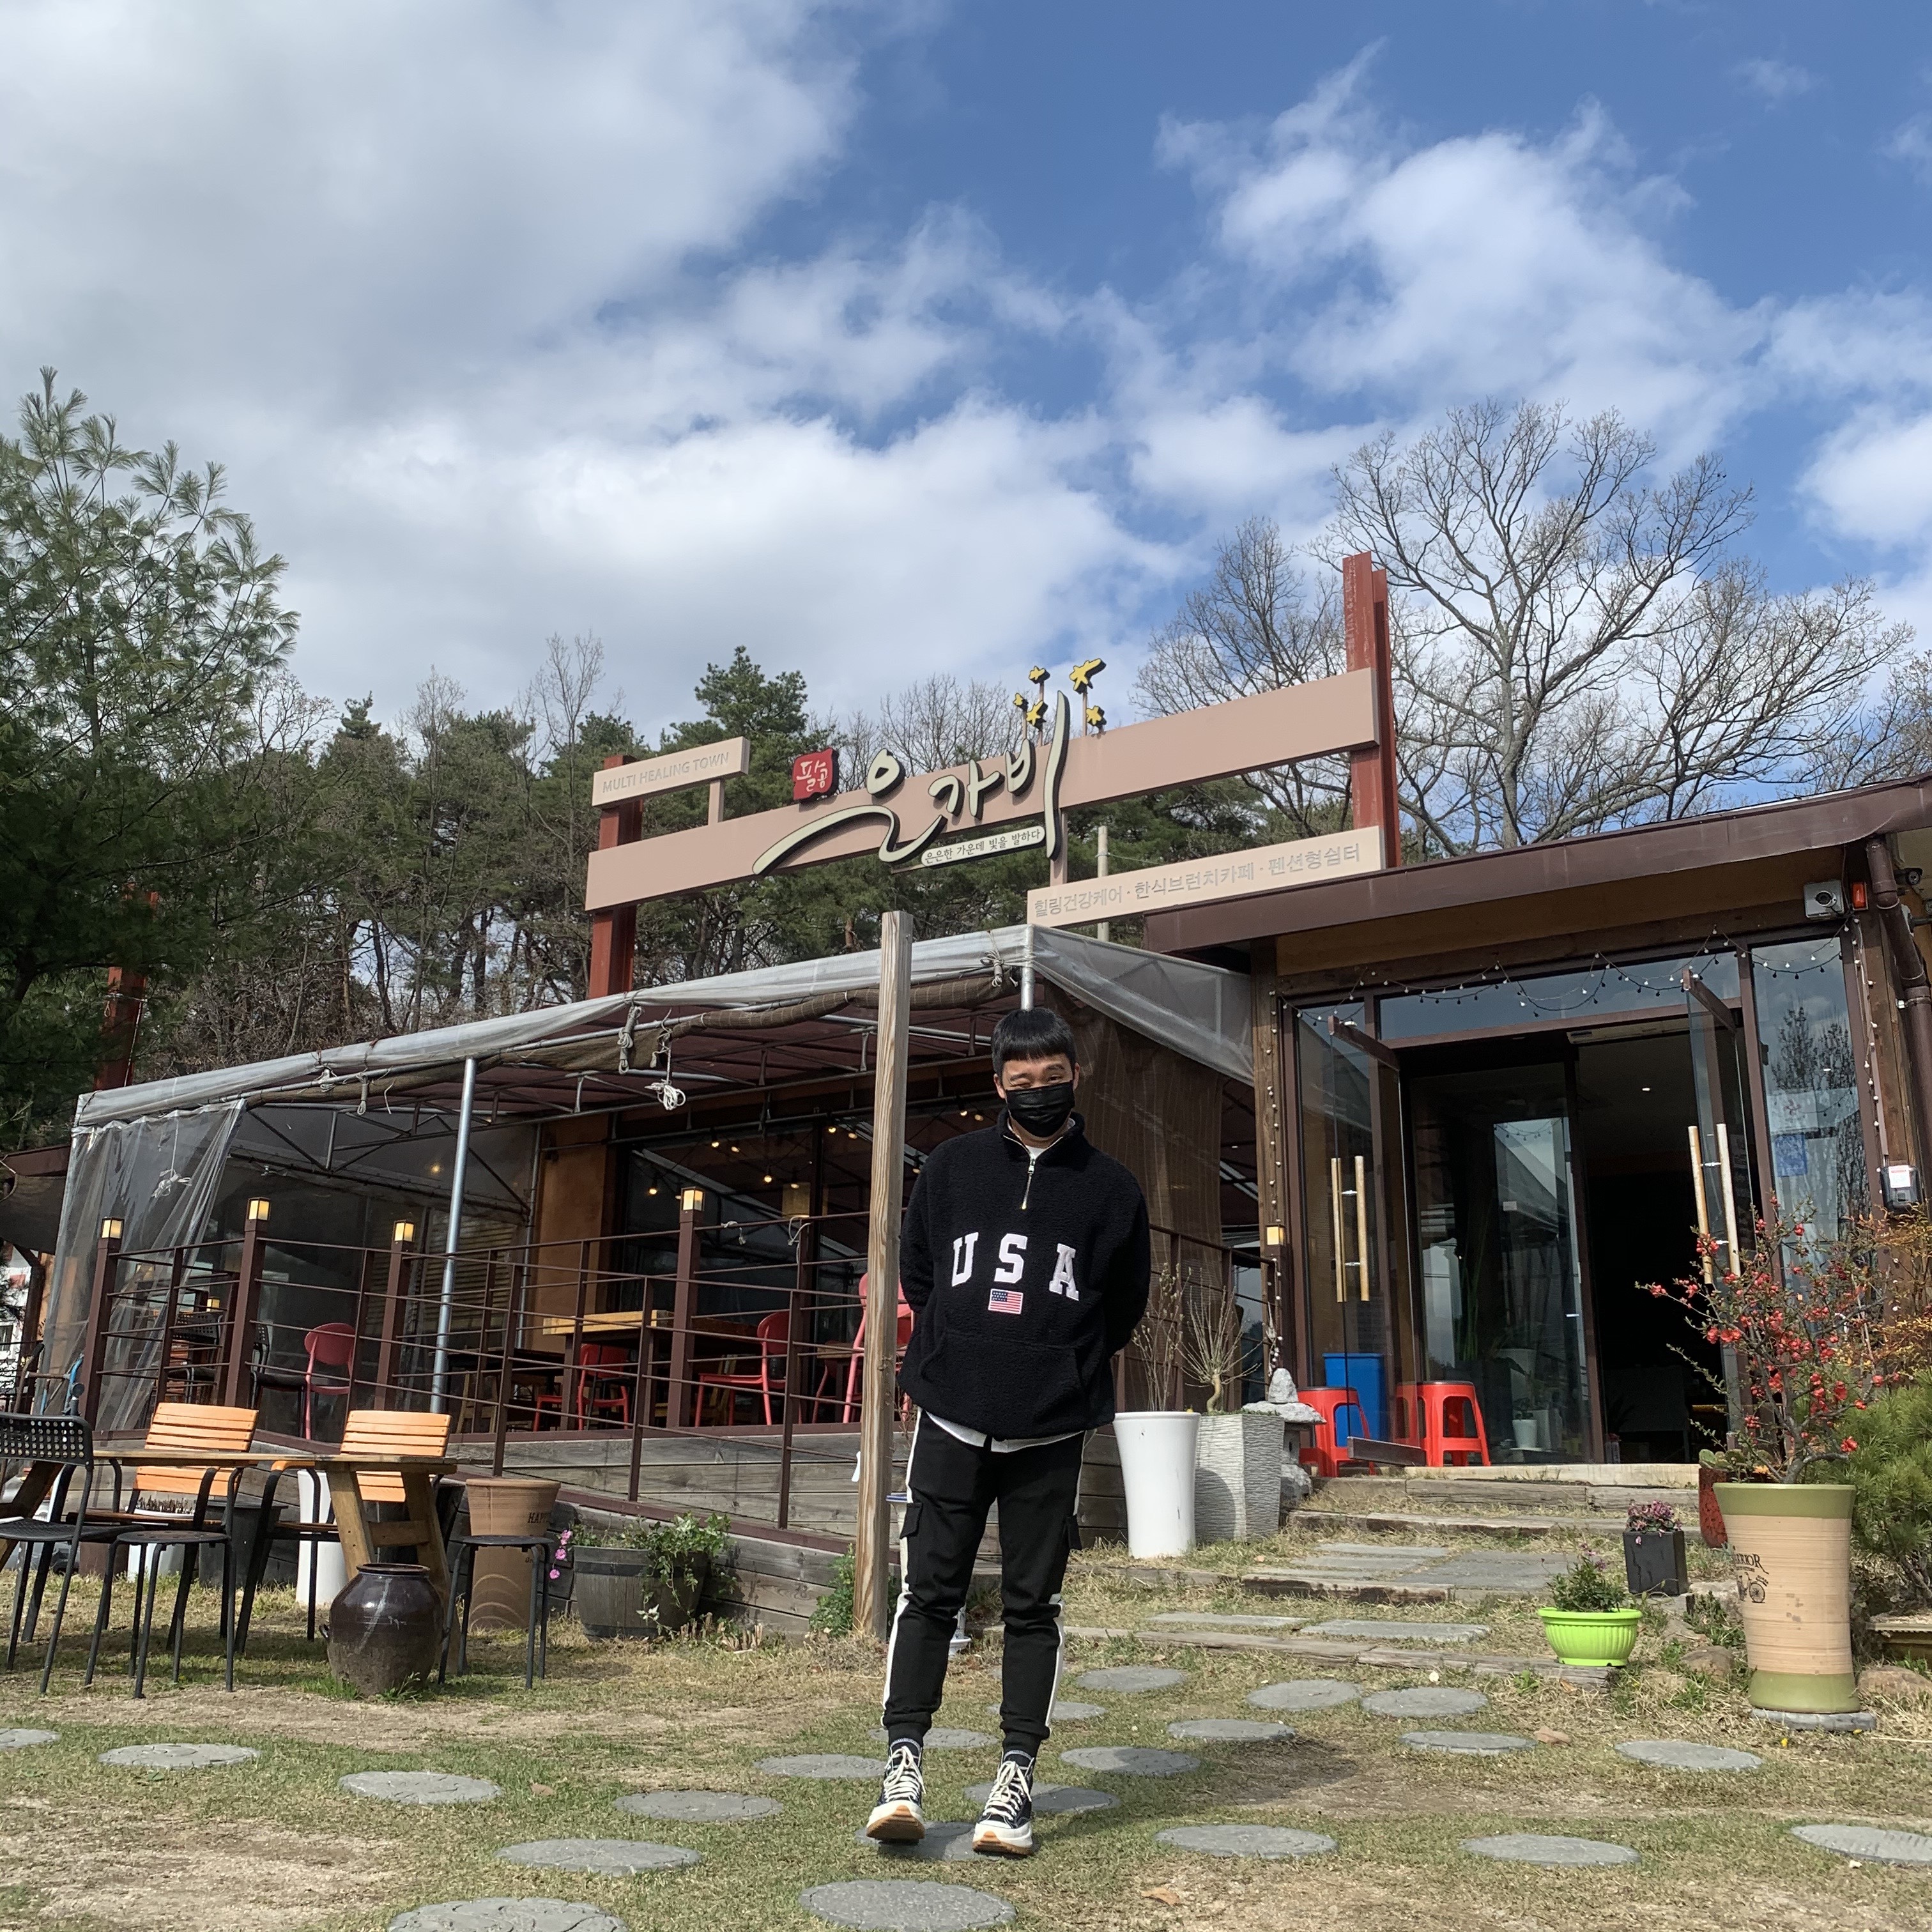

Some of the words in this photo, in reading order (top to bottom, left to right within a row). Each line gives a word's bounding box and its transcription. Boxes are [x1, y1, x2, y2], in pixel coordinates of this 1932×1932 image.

[602, 774, 636, 793] MULTI
[639, 762, 690, 784] HEALING
[693, 752, 729, 771] TOWN
[796, 760, 828, 792] 팔공
[925, 848, 953, 864] 은은한
[956, 841, 985, 855] 가운데
[989, 836, 1008, 851] 빛을
[1011, 829, 1041, 846] 발하다
[1034, 885, 1123, 918] 힐링건강케어
[1135, 862, 1254, 900] 한식브런치카페
[1268, 843, 1360, 877] 펜션형쉼터
[952, 1232, 1079, 1301] USA
